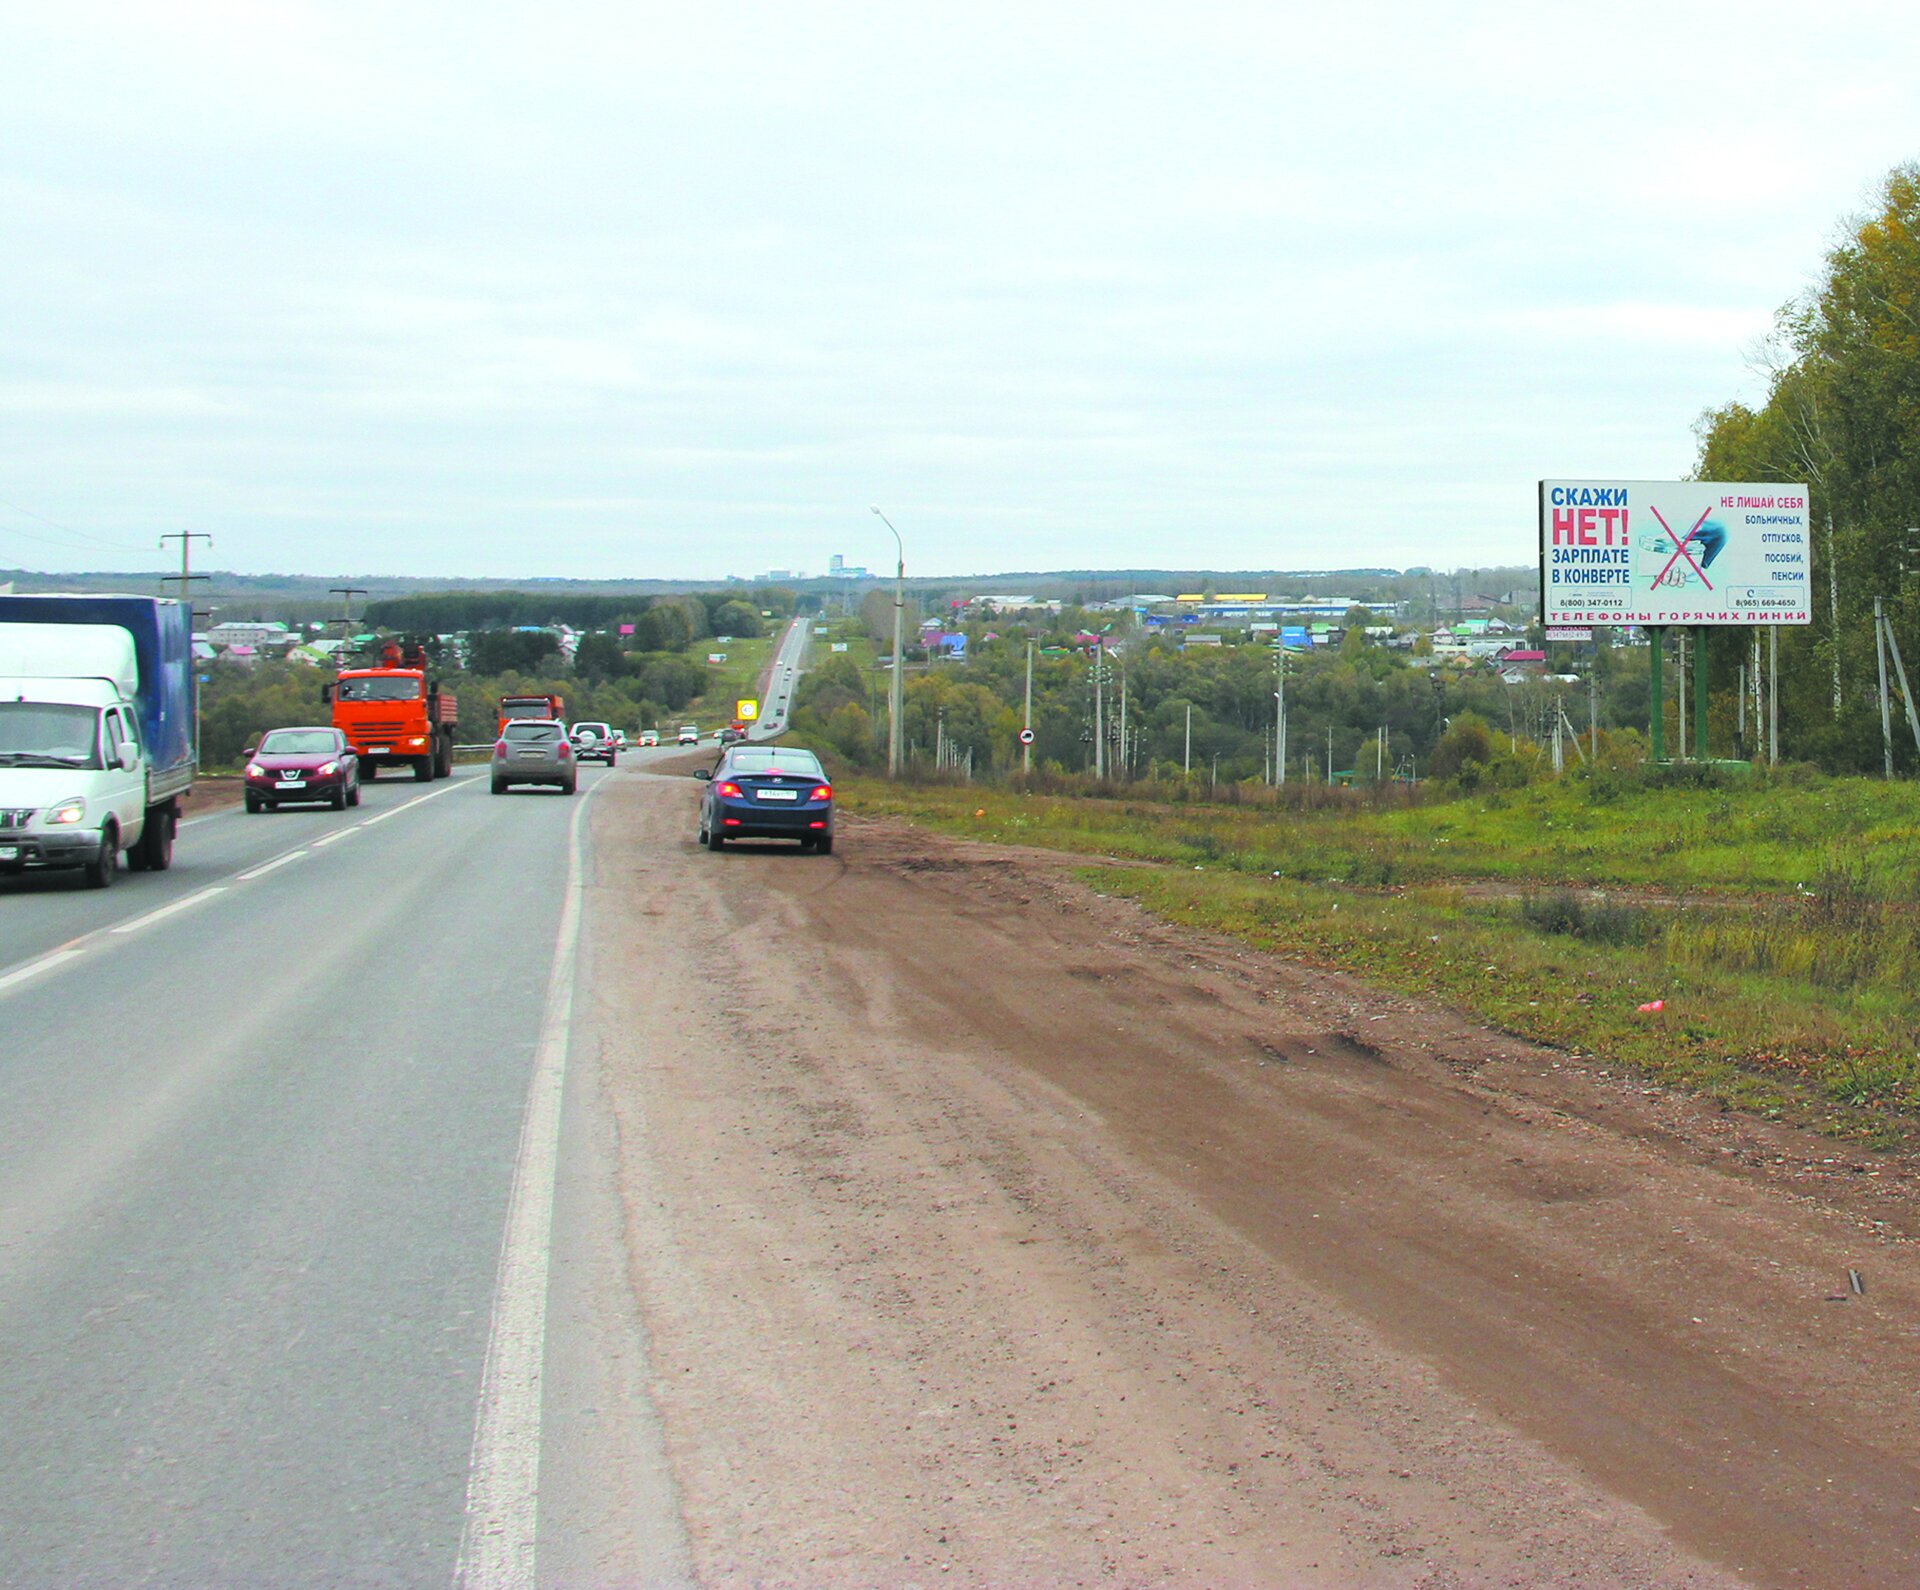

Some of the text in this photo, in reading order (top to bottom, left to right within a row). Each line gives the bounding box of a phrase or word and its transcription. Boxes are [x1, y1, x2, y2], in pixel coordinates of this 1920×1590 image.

[1551, 488, 1627, 506] СКАЖИ
[1721, 495, 1804, 509] НЕ ЛИШАЙ СЕБЯ
[1745, 515, 1802, 525] БОЛЬНИЧНЫХ,
[1553, 508, 1628, 545] НЕТ!
[1762, 533, 1803, 543] ОТПУСКОВ,
[1552, 548, 1629, 563] ЗАРПЛАТЕ
[1765, 552, 1804, 563] ПОСОБИЙ,
[1552, 569, 1630, 583] В КОНВЕРТЕ
[1772, 572, 1804, 580] ПЕНСИИ
[1560, 599, 1623, 608] 8(800) 347-0112
[1736, 599, 1760, 607] 8(965)
[1550, 610, 1806, 621] ТЕЛЕФОНЫ ГОРЯЧИХ ЛИНИЙ
